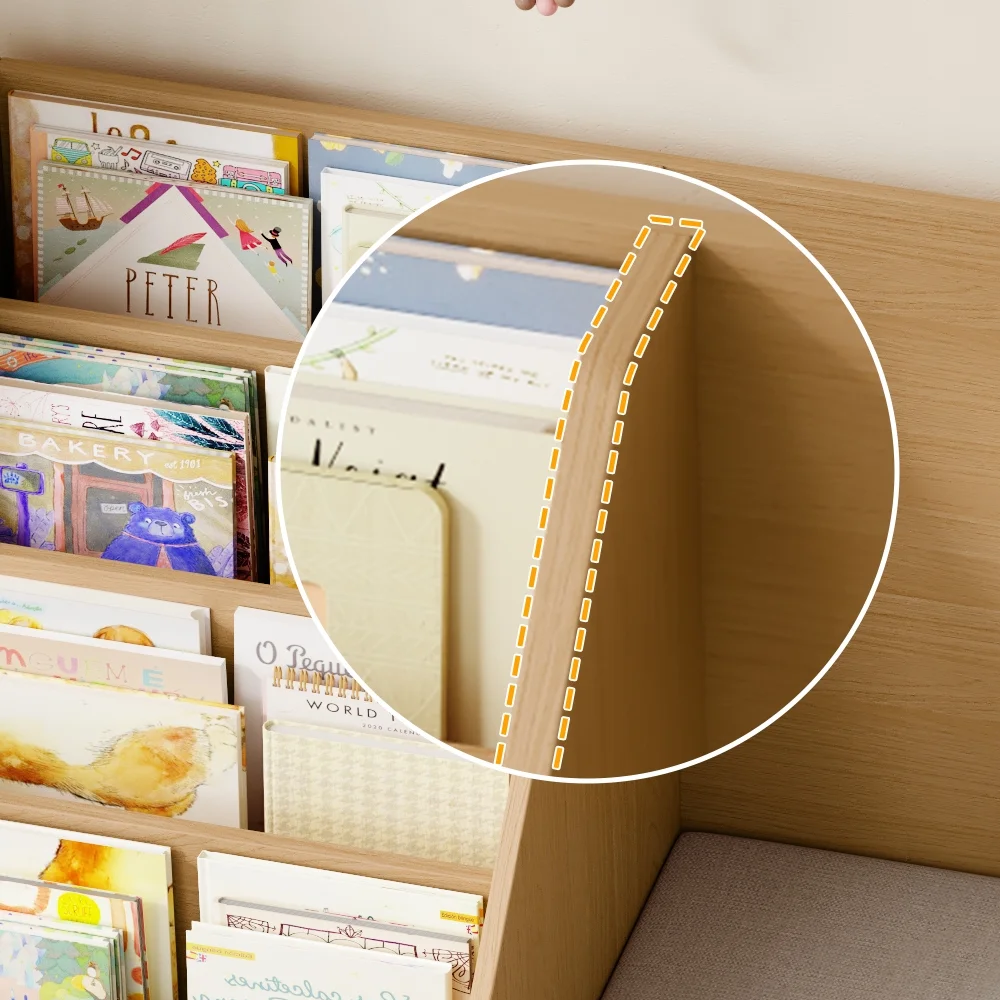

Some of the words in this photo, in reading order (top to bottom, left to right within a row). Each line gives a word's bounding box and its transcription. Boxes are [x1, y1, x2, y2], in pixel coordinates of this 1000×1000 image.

[125, 267, 221, 326] PETER
[18, 432, 155, 465] BAKERY
[256, 641, 277, 665] O
[286, 645, 355, 681] Pequ
[306, 699, 378, 719] WORLD
[362, 723, 383, 731] 2020
